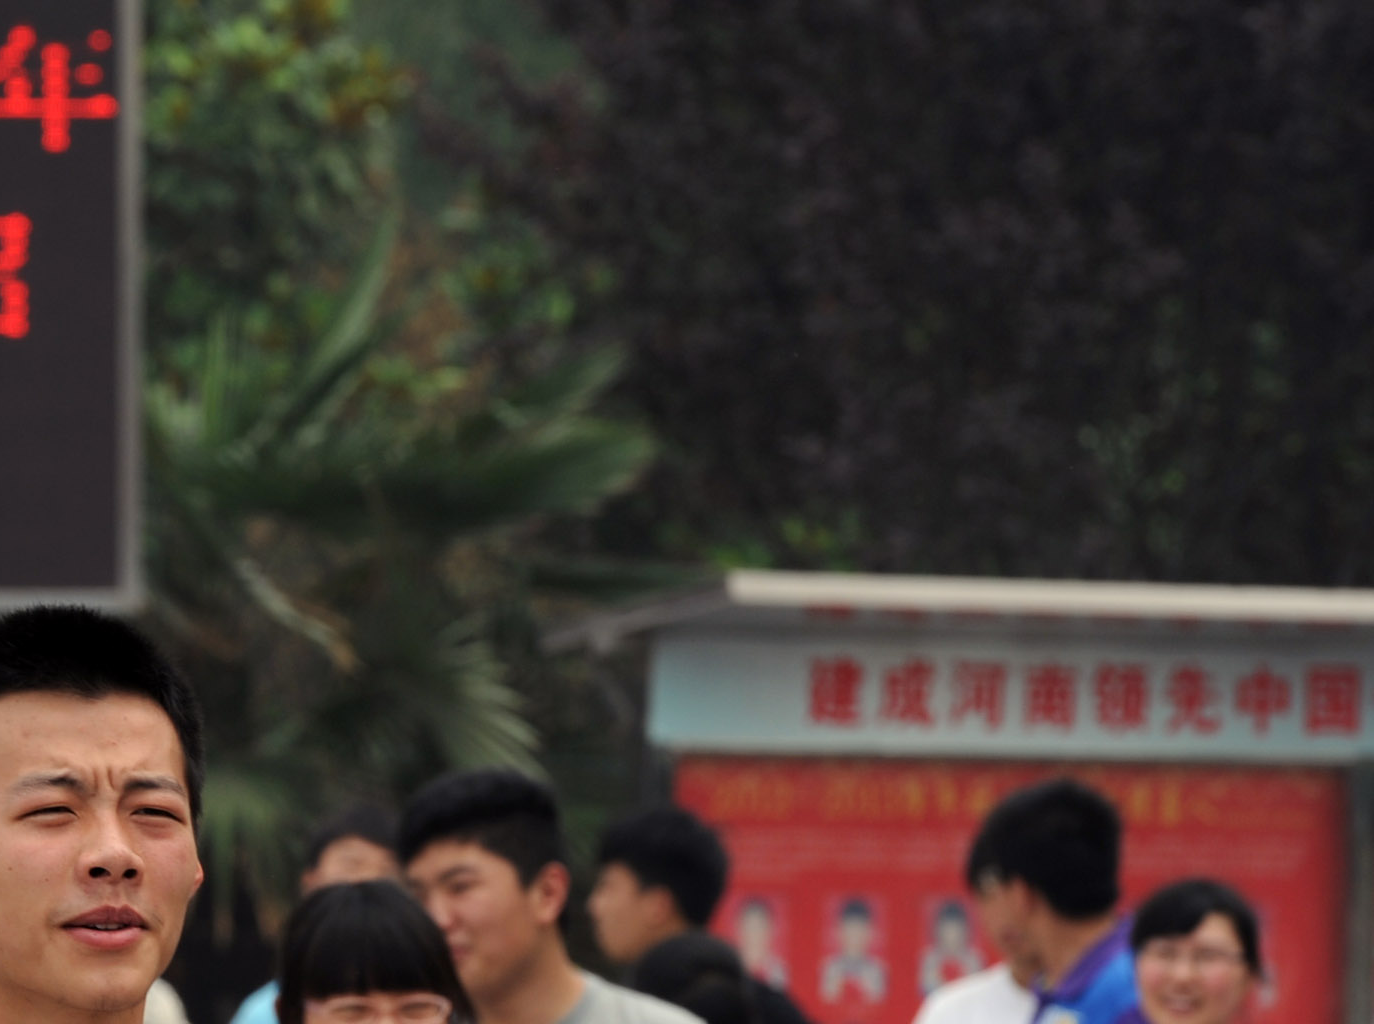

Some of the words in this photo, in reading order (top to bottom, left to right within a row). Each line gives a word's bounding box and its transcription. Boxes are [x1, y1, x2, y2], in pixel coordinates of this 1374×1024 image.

[807, 655, 1363, 738] 建成河南领先中国
